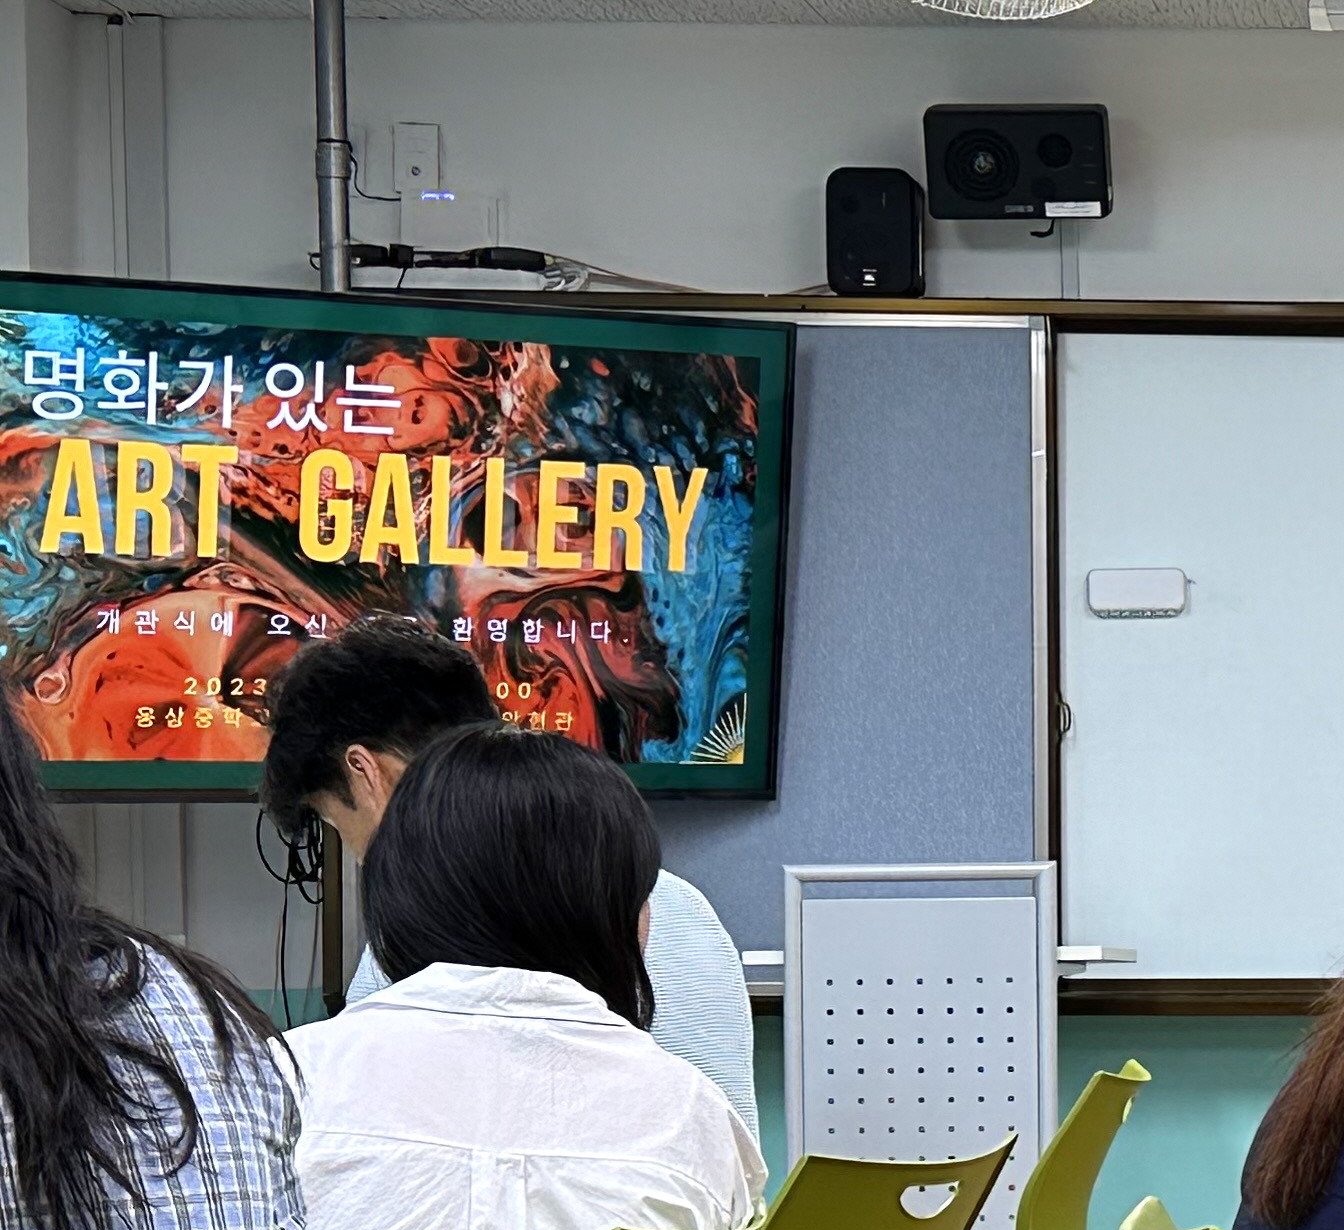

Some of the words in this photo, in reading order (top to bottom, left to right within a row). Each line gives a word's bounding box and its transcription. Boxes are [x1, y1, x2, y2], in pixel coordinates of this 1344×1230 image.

[24, 347, 243, 429] 명화가
[265, 361, 403, 436] 있는
[39, 438, 239, 560] ART
[298, 447, 710, 573] GALLERY
[97, 608, 233, 636] 개관식에
[267, 613, 328, 639] 오신
